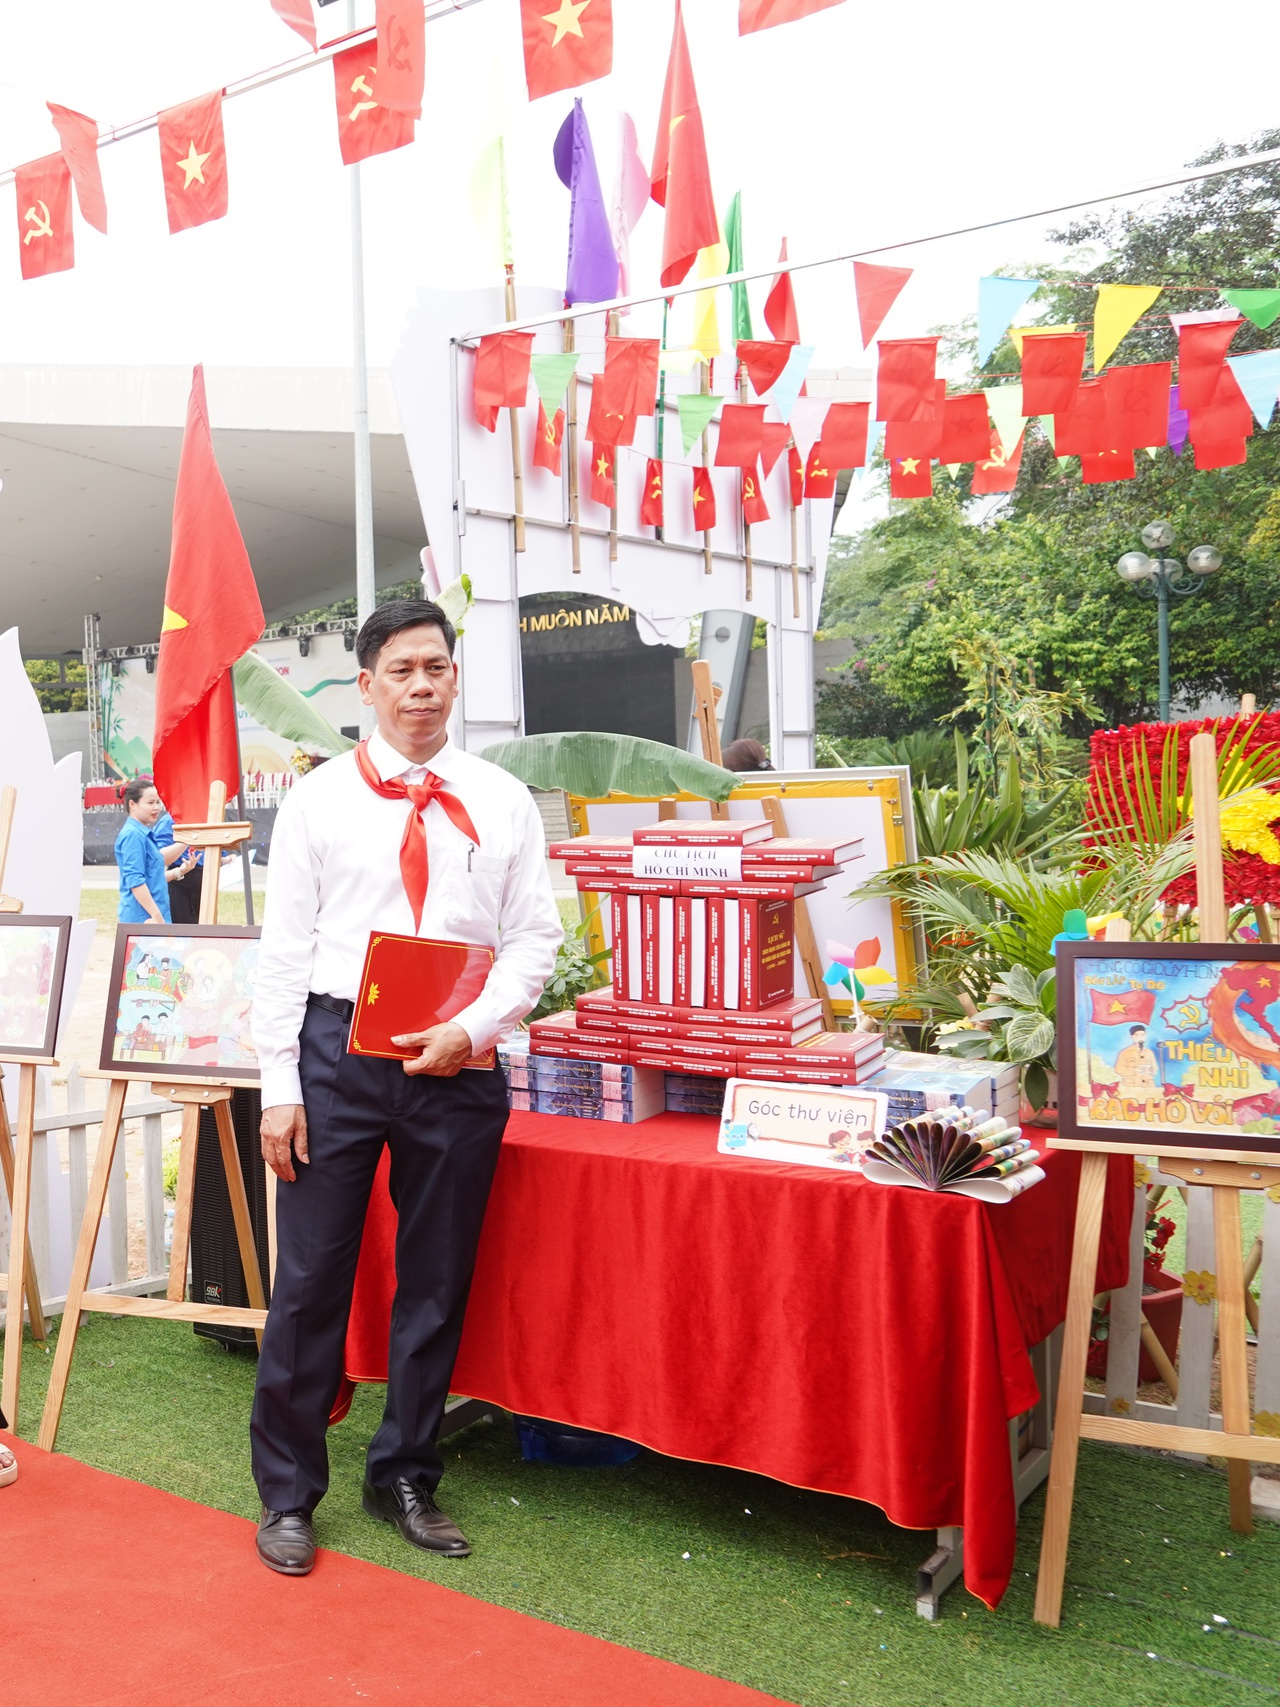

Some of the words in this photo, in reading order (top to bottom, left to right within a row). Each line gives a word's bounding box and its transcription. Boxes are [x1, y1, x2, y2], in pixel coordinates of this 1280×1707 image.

[531, 608, 583, 632] MUÔN
[585, 603, 631, 626] NĂM
[665, 863, 689, 876] CHÍ
[693, 866, 729, 878] MINH
[748, 1100, 781, 1116] Góc
[788, 1103, 822, 1121] thư
[827, 1108, 868, 1128] viện
